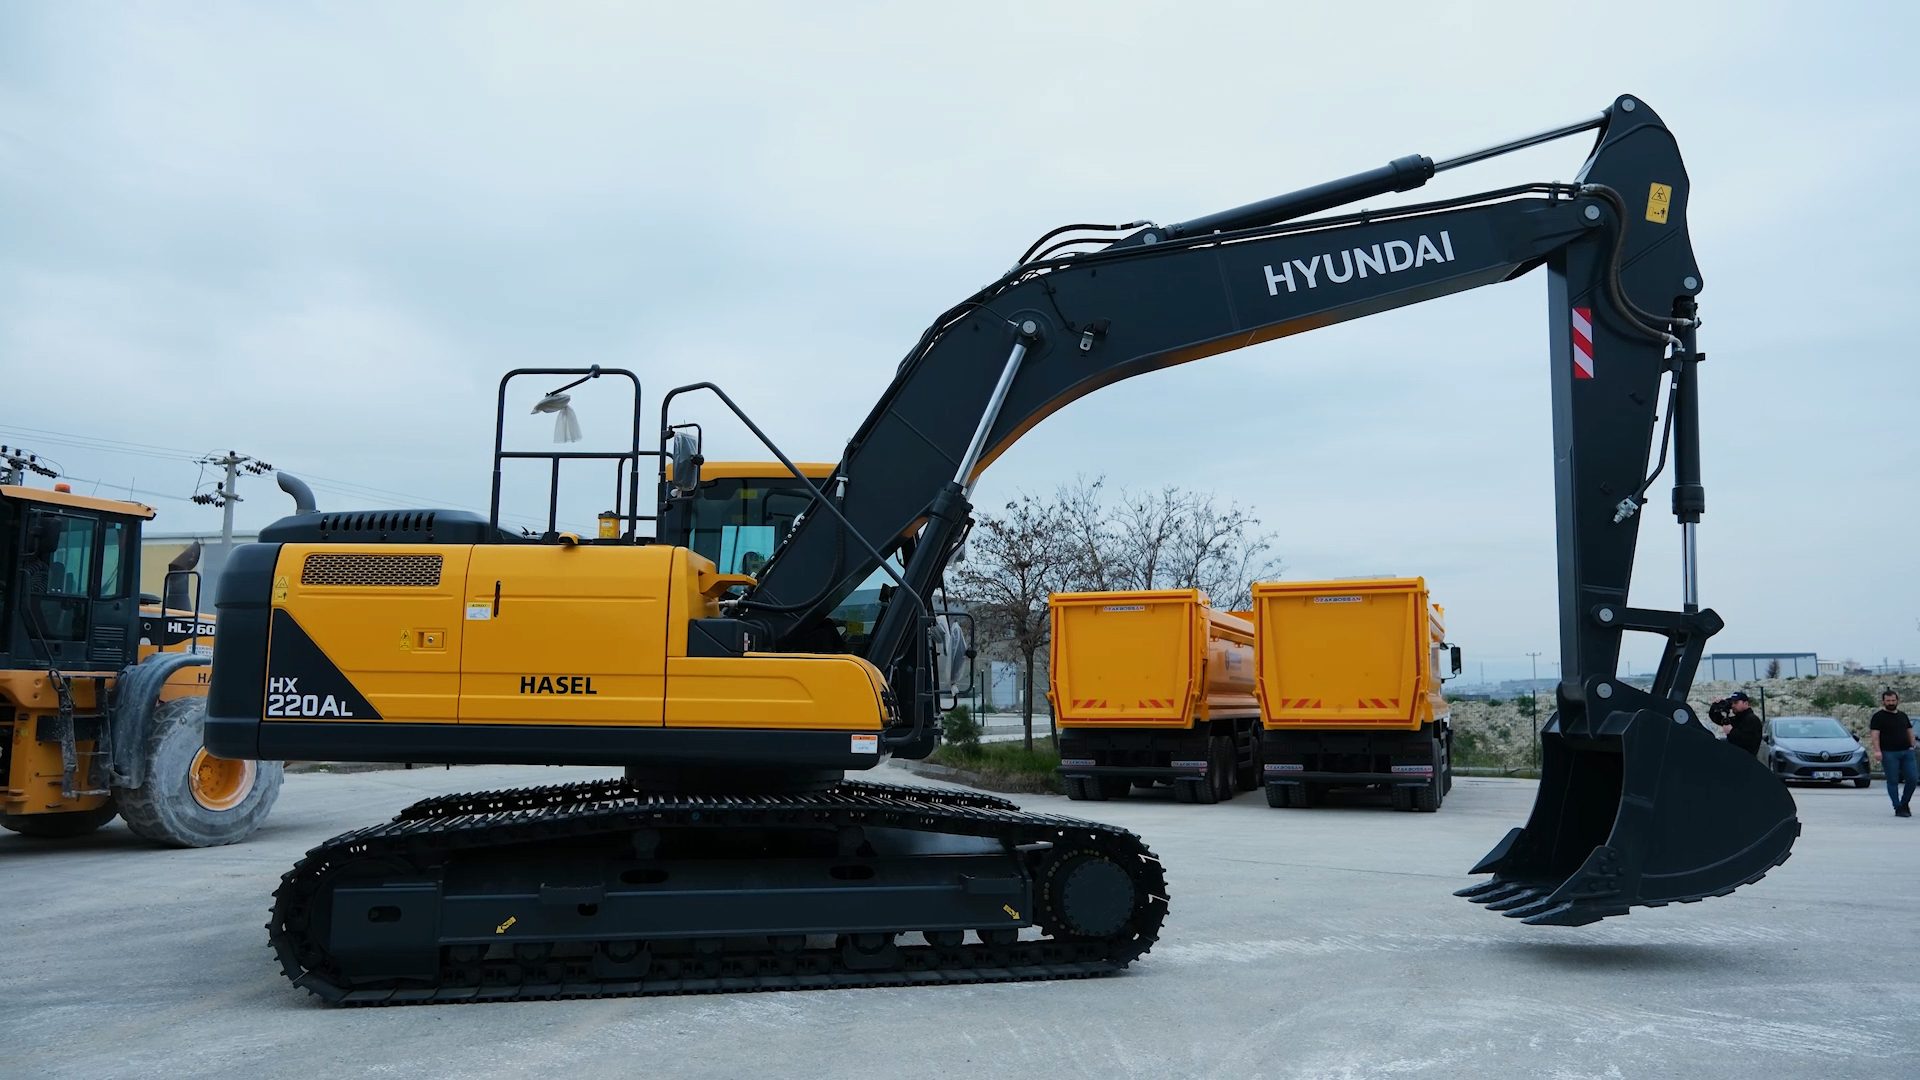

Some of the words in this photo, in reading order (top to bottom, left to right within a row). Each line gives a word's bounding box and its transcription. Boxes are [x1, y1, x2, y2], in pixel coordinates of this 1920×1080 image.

[1264, 230, 1456, 296] HYUNDAI
[168, 622, 216, 635] HL760
[269, 677, 298, 693] HX
[520, 676, 597, 694] HASEL
[268, 694, 353, 717] 220AL
